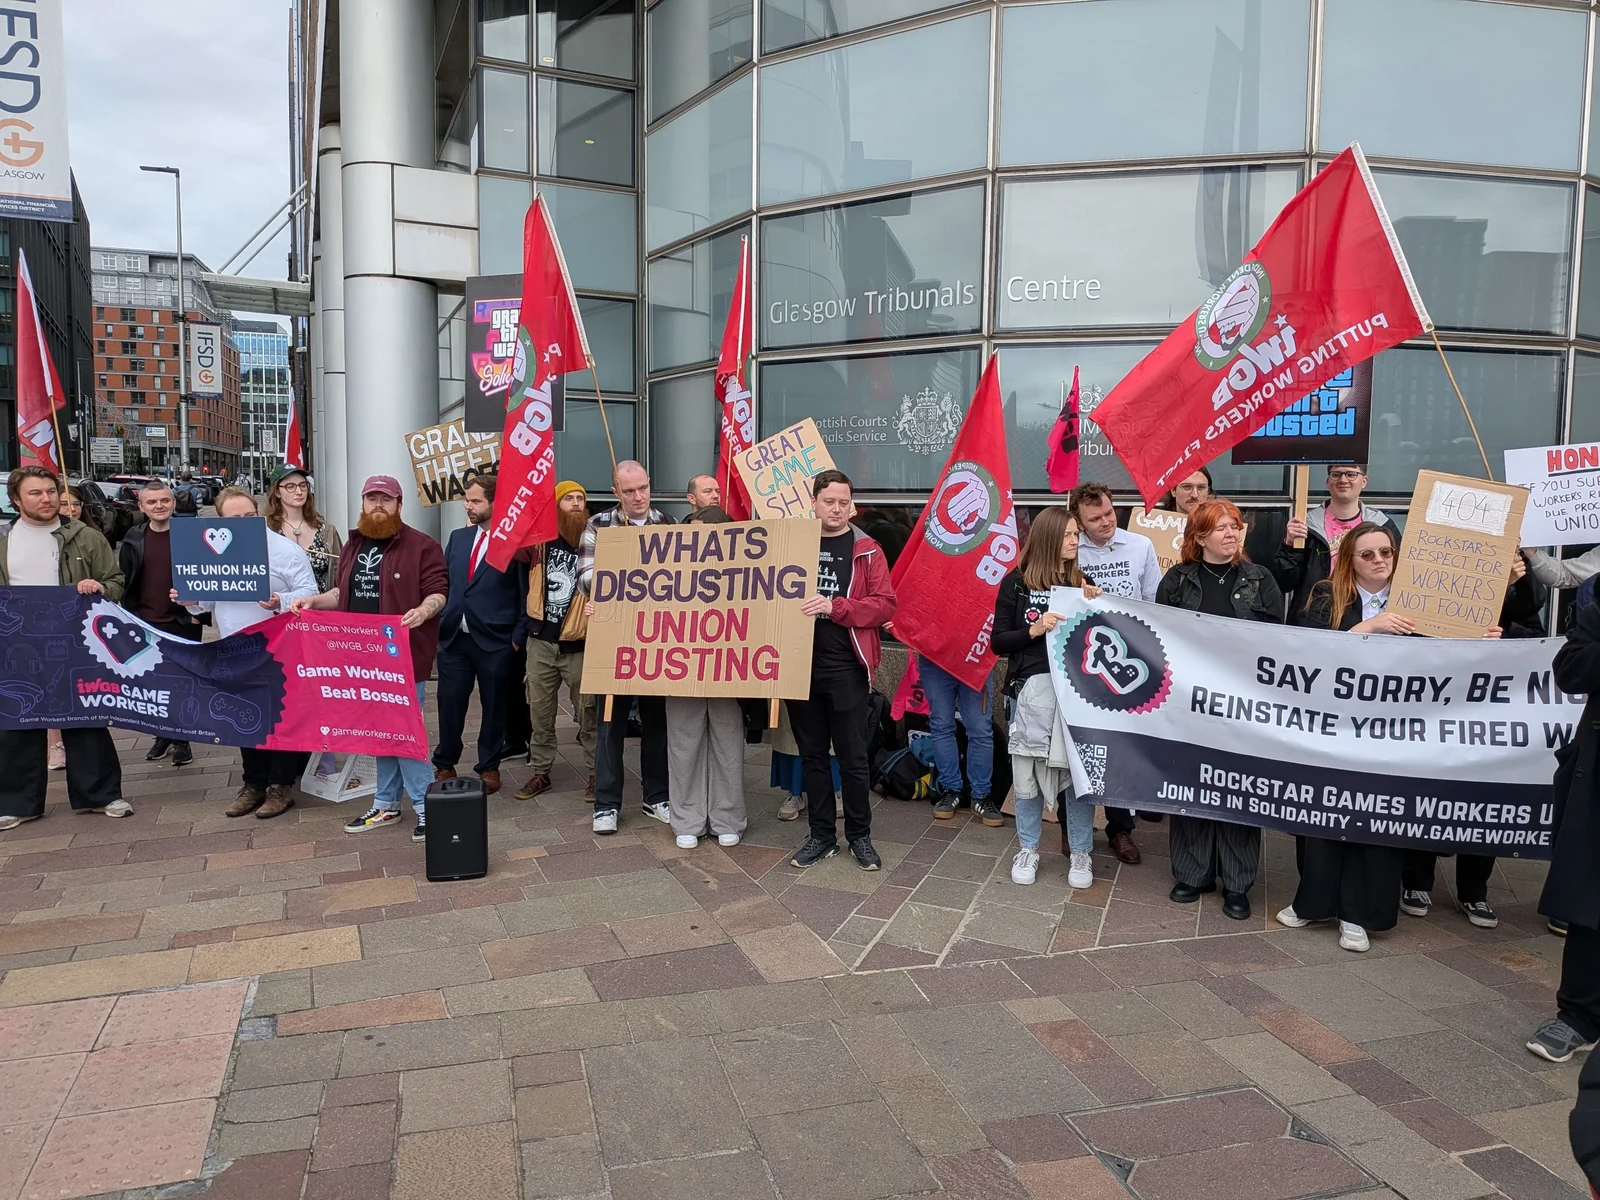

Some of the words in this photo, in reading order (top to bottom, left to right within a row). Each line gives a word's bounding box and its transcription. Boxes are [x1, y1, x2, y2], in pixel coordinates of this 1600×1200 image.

[0, 0, 41, 114] FSD
[0, 169, 45, 180] ASGOW
[770, 297, 857, 325] Glasgow
[864, 279, 975, 315] Tribunals
[1007, 274, 1102, 302] Centre
[492, 309, 521, 329] gra
[815, 415, 847, 429] ottish
[849, 415, 888, 428] Courts
[745, 425, 804, 472] GREAT
[846, 429, 887, 442] Service
[416, 441, 499, 487] THEFT
[754, 444, 826, 497] GAME
[766, 476, 817, 519] SHI
[1541, 479, 1570, 493] YOU
[1441, 489, 1490, 523] 404
[1533, 491, 1582, 508] WORKER'S
[1545, 508, 1568, 519] DUE
[1554, 513, 1600, 532] UNIO
[638, 526, 768, 565] WHATS
[1417, 529, 1498, 557] ROCKSTAR'S
[175, 564, 198, 575] THE
[200, 564, 240, 575] UNION
[242, 564, 266, 575] HAS
[1101, 560, 1130, 570] GAME
[1407, 546, 1470, 570] RESPECT
[1475, 558, 1503, 576] FOR
[186, 580, 219, 591] YOUR
[221, 580, 257, 592] BACK!
[594, 565, 808, 603] DISGUSTING
[1411, 564, 1496, 602] WORKERS
[1395, 590, 1434, 613] NOT
[1437, 598, 1494, 628] FOUND
[311, 622, 339, 633] Game
[341, 625, 379, 636] Workers
[636, 608, 749, 644] UNION
[327, 640, 383, 653] @IWGB_GW
[296, 664, 341, 678] Game
[344, 665, 406, 684] Workers
[614, 645, 780, 682] BUSTING
[120, 683, 171, 704] GAME
[1256, 655, 1322, 694] SAY
[1333, 667, 1454, 706] SORRY,
[1466, 672, 1514, 704] BE
[79, 694, 169, 719] WORKERS
[320, 685, 357, 700] Beat
[360, 687, 410, 706] Bosses
[1190, 685, 1339, 737] REINSTATE
[1350, 716, 1426, 742] YOUR
[1438, 719, 1529, 748] FIRED
[198, 729, 216, 737] Britain
[331, 727, 416, 743] gameworkers.co.uk
[1200, 763, 1314, 804] ROCKSTAR
[1322, 785, 1405, 816] GAMES
[1415, 796, 1531, 824] WORKERS
[1157, 781, 1195, 802] JOIN
[1199, 788, 1221, 806] US
[1227, 794, 1243, 810] IN
[1249, 797, 1351, 830] SOLIDARITY
[1370, 818, 1552, 846] WWW.GAMEWORKE
